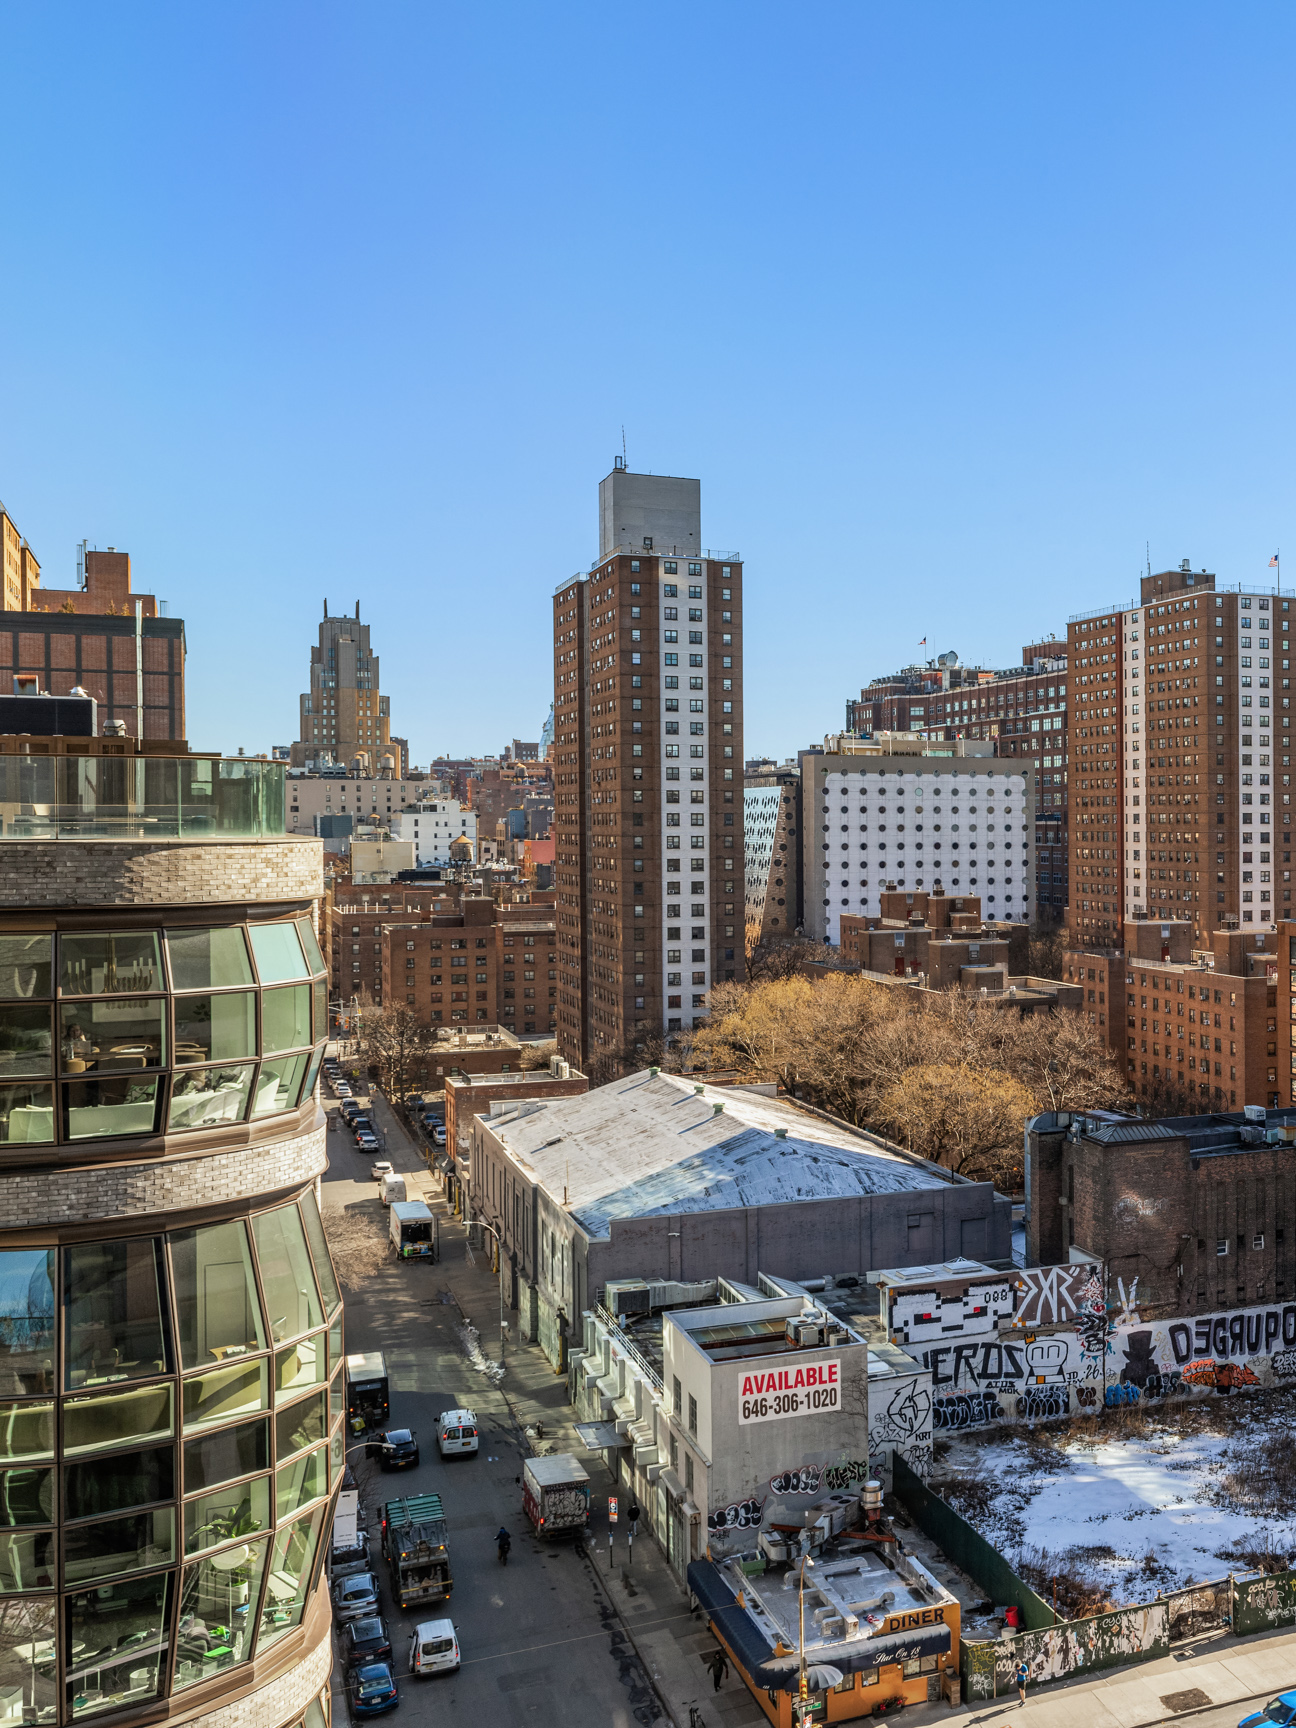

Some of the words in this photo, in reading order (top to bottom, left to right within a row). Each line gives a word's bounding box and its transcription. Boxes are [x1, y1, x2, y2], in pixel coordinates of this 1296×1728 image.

[742, 1364, 838, 1396] AVAILABLE
[742, 1387, 837, 1420] 646-306-1020
[890, 1608, 944, 1631] DINER
[872, 1652, 894, 1665] Star
[895, 1647, 908, 1659] On
[910, 1645, 922, 1656] 18
